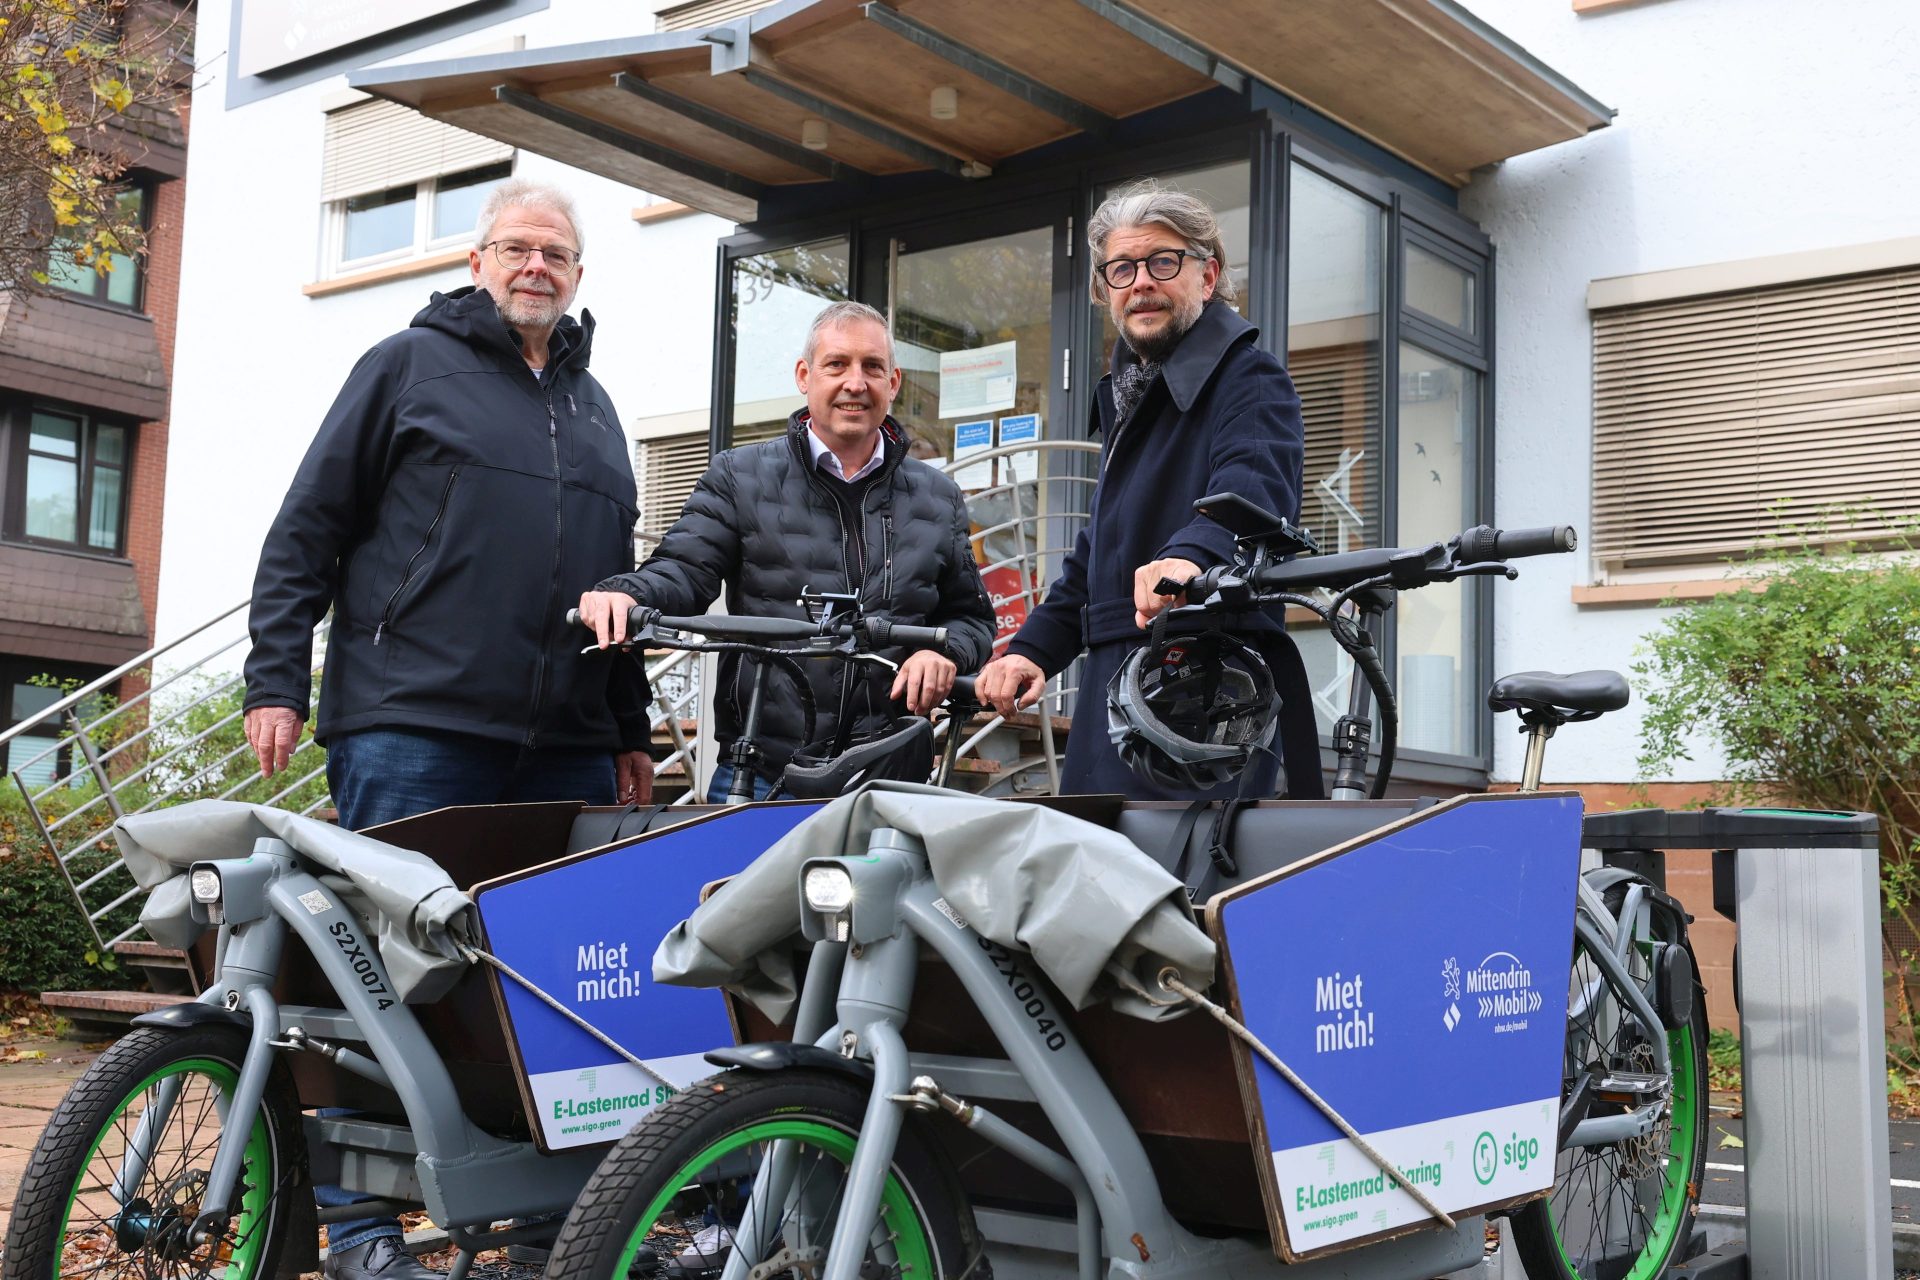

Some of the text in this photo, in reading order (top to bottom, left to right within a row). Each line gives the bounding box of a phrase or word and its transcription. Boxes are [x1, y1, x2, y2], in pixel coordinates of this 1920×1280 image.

[743, 268, 775, 305] 39
[329, 921, 395, 1011] S2X0074
[577, 941, 628, 972] Miet
[577, 968, 640, 1002] mich!
[1315, 971, 1363, 1012] Miet
[1466, 963, 1531, 994] Mittendrin
[1316, 1009, 1374, 1054] mich!
[553, 1087, 650, 1120] E-Lastenrad
[561, 1118, 621, 1135] www.sigo.green
[1503, 1131, 1539, 1171] sigo
[1296, 1168, 1385, 1212] E-Lastenrad
[1303, 1210, 1359, 1232] www.sigo.green
